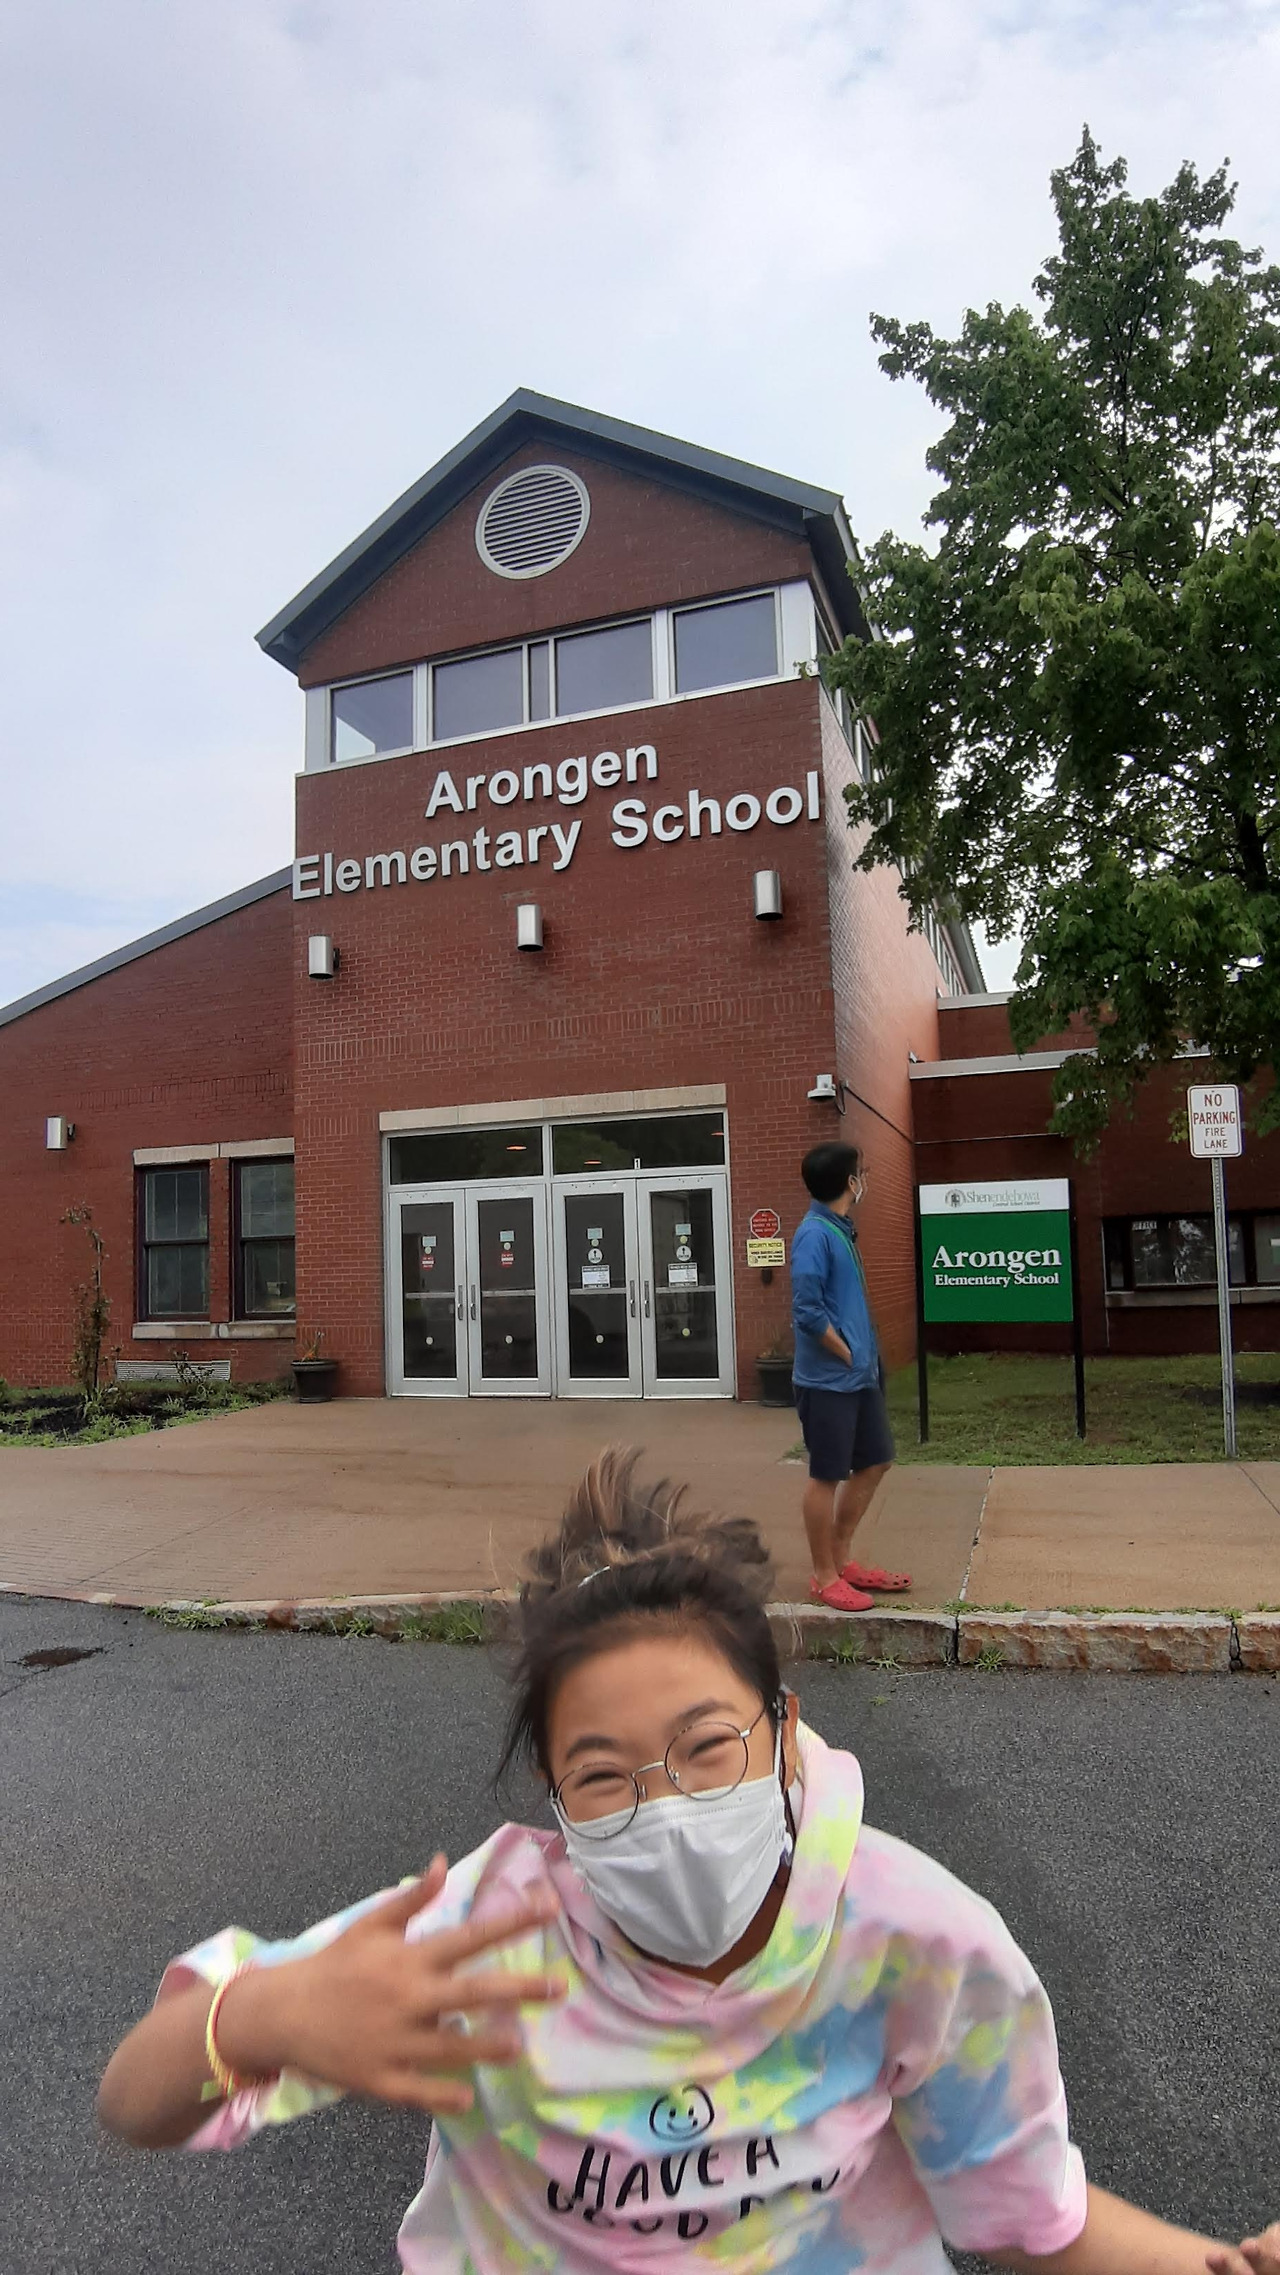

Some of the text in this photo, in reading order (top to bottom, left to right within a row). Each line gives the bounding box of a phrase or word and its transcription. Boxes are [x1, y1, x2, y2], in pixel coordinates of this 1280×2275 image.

[425, 744, 658, 818] Arongen
[291, 770, 822, 901] Elementary School
[1204, 1093, 1222, 1107] NO
[1193, 1111, 1236, 1125] PARKING
[1205, 1127, 1226, 1137] FIRE
[1204, 1139, 1228, 1149] LANE
[931, 1245, 1063, 1274] Arongen
[934, 1272, 1060, 1288] Elementary School
[573, 2145, 724, 2212] HAVE
